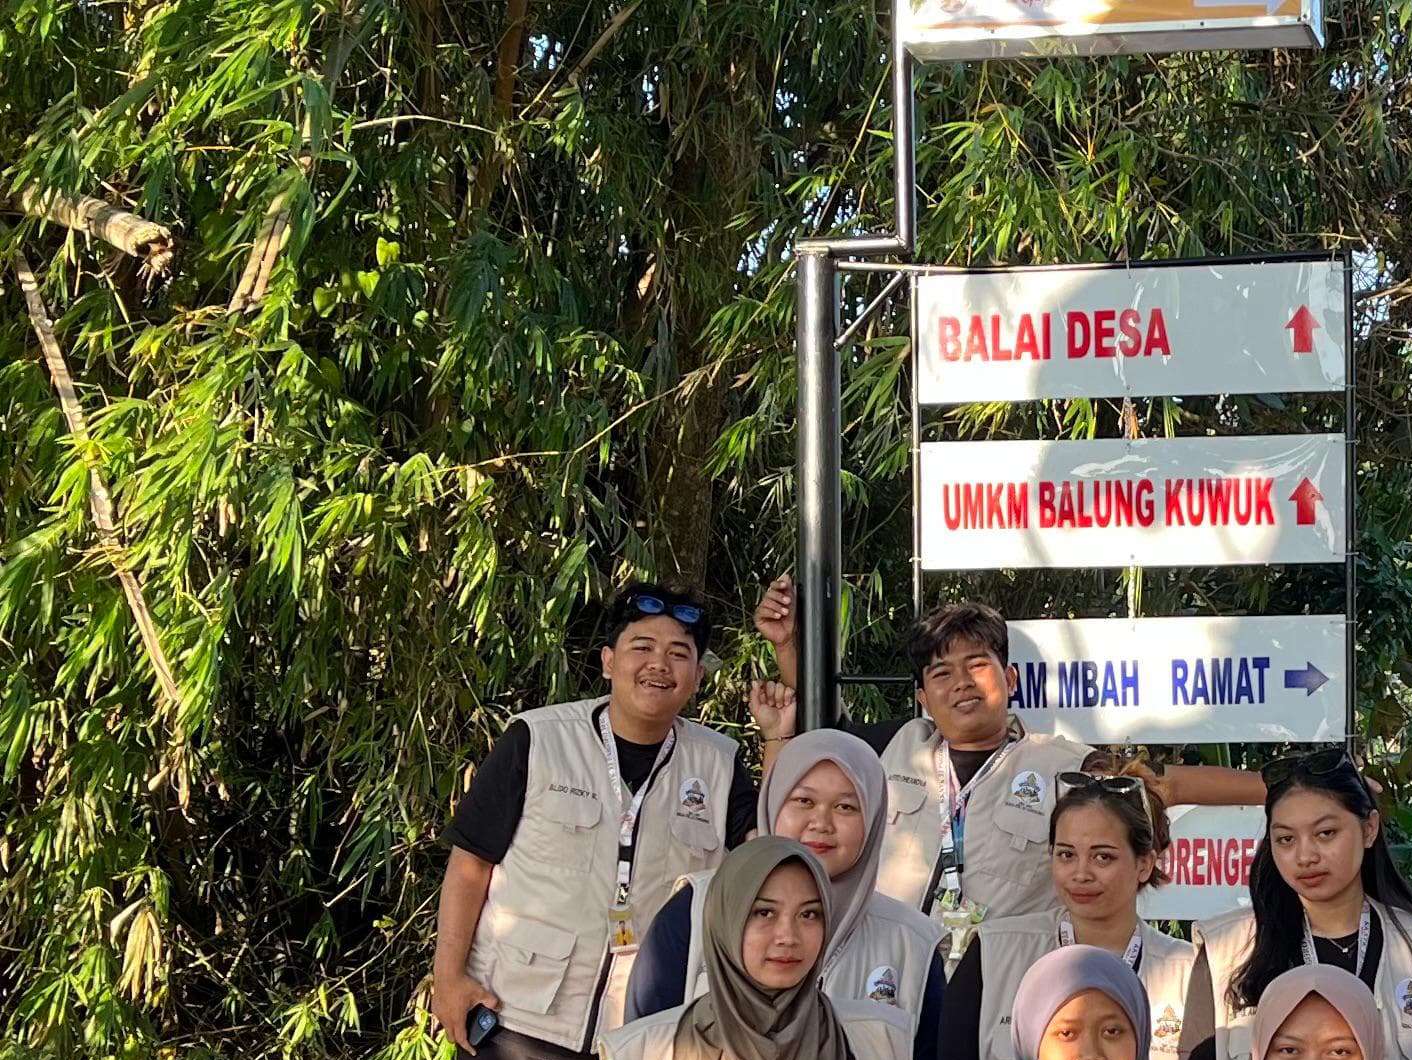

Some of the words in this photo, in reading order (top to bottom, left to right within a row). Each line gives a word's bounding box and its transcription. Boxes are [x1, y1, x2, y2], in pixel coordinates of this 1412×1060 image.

[938, 312, 1052, 362] BALAI
[1066, 307, 1171, 360] DESA
[943, 481, 1029, 531] UMKM
[1038, 478, 1155, 529] BALUNG
[1165, 477, 1275, 527] KUWUK
[1058, 659, 1140, 708] MBAH
[1171, 656, 1270, 706] RAMAT
[1160, 837, 1263, 887] ORENGE
